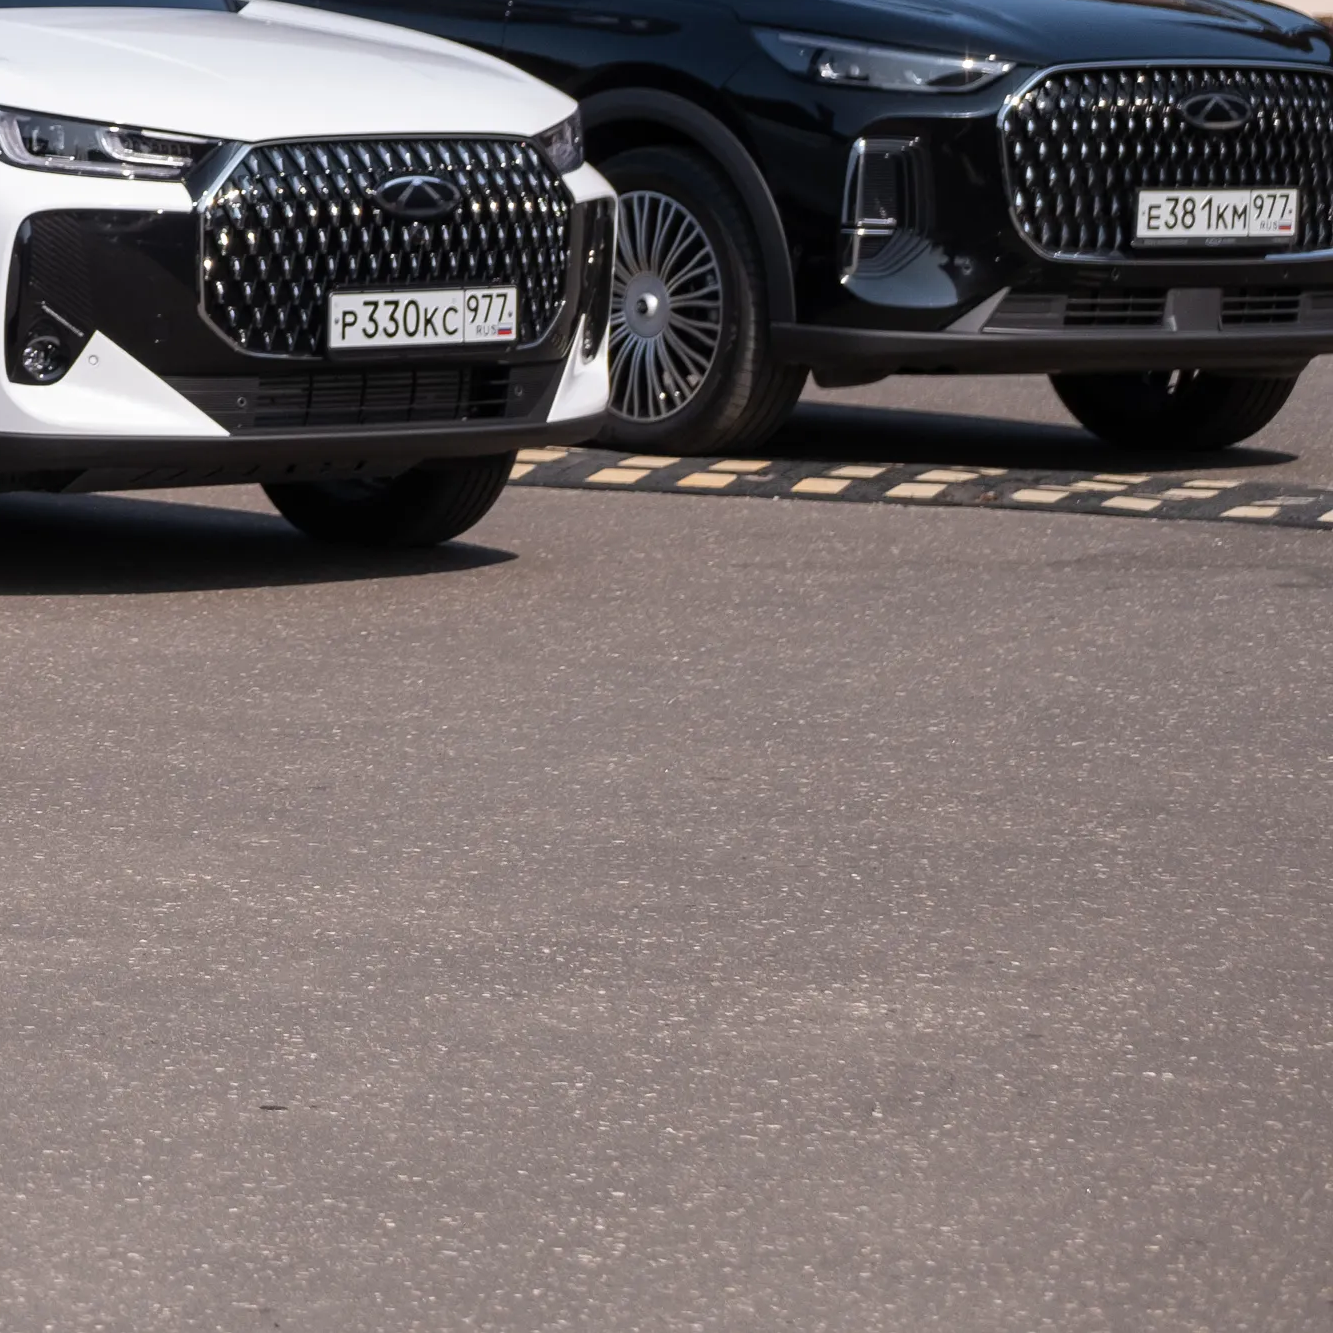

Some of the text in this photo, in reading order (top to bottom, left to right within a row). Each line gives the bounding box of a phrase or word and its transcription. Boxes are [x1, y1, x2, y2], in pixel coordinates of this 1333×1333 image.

[1253, 193, 1290, 220] 977
[465, 293, 508, 324] 977
[475, 324, 497, 335] RUS
